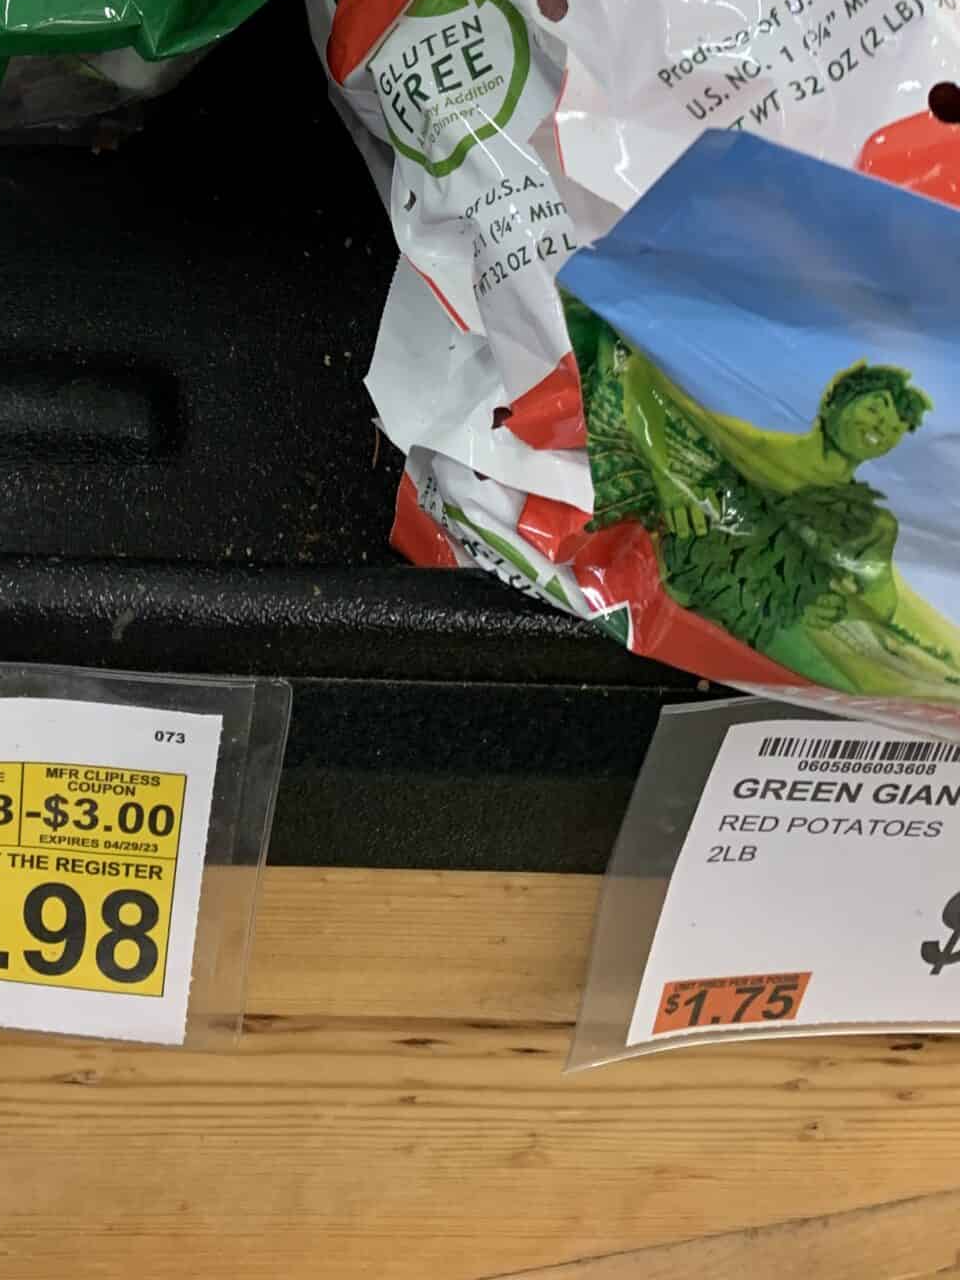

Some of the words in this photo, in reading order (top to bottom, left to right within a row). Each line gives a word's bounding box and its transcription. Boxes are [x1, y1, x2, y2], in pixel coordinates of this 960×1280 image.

[757, 8, 782, 34] of
[379, 15, 483, 96] GLUTEN
[392, 37, 494, 134] FREE
[443, 73, 506, 107] Addition
[750, 88, 781, 126] WT
[788, 76, 826, 102] 32
[827, 46, 859, 83] OZ
[860, 29, 885, 58] (2
[686, 87, 730, 121] U.S.
[486, 174, 546, 207] U.S.A.
[507, 241, 532, 272] OZ
[154, 730, 186, 744] 073
[45, 767, 79, 780] MFR
[84, 769, 161, 787] CLIPLESS
[797, 760, 936, 776] 0605806003608
[67, 780, 136, 797] COUPON
[733, 778, 863, 803] GREEN
[872, 783, 960, 806] GIAN
[25, 794, 176, 838] -$3.00
[718, 815, 779, 832] RED
[786, 816, 943, 838] POTATOES
[39, 834, 100, 849] EXPIRES
[103, 840, 159, 853] 04/29/23
[707, 845, 757, 863] 2LB
[7, 853, 49, 871] THE
[55, 858, 163, 881] REGISTER
[664, 984, 799, 1026] $1.75
